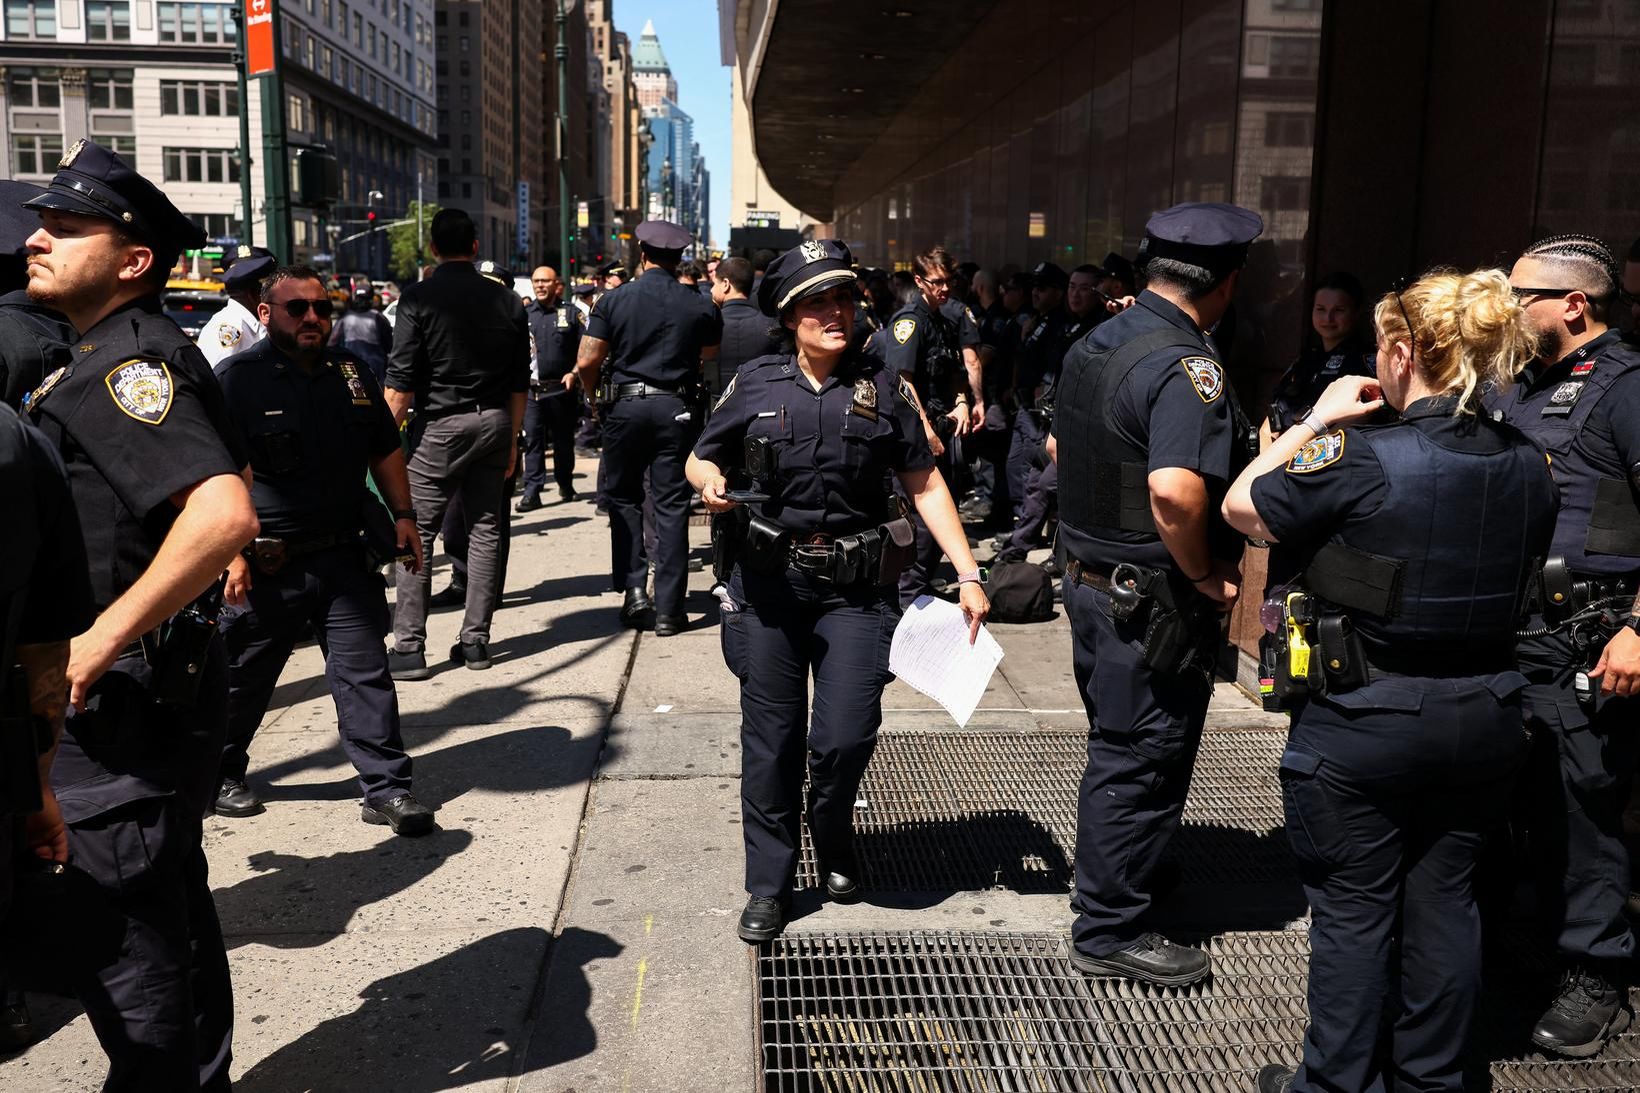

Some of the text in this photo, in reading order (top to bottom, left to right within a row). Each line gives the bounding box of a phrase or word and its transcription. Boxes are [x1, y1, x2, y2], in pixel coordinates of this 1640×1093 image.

[115, 367, 163, 393] DEPARTMENT
[120, 363, 148, 379] POLICE
[121, 397, 146, 416] CITY OF
